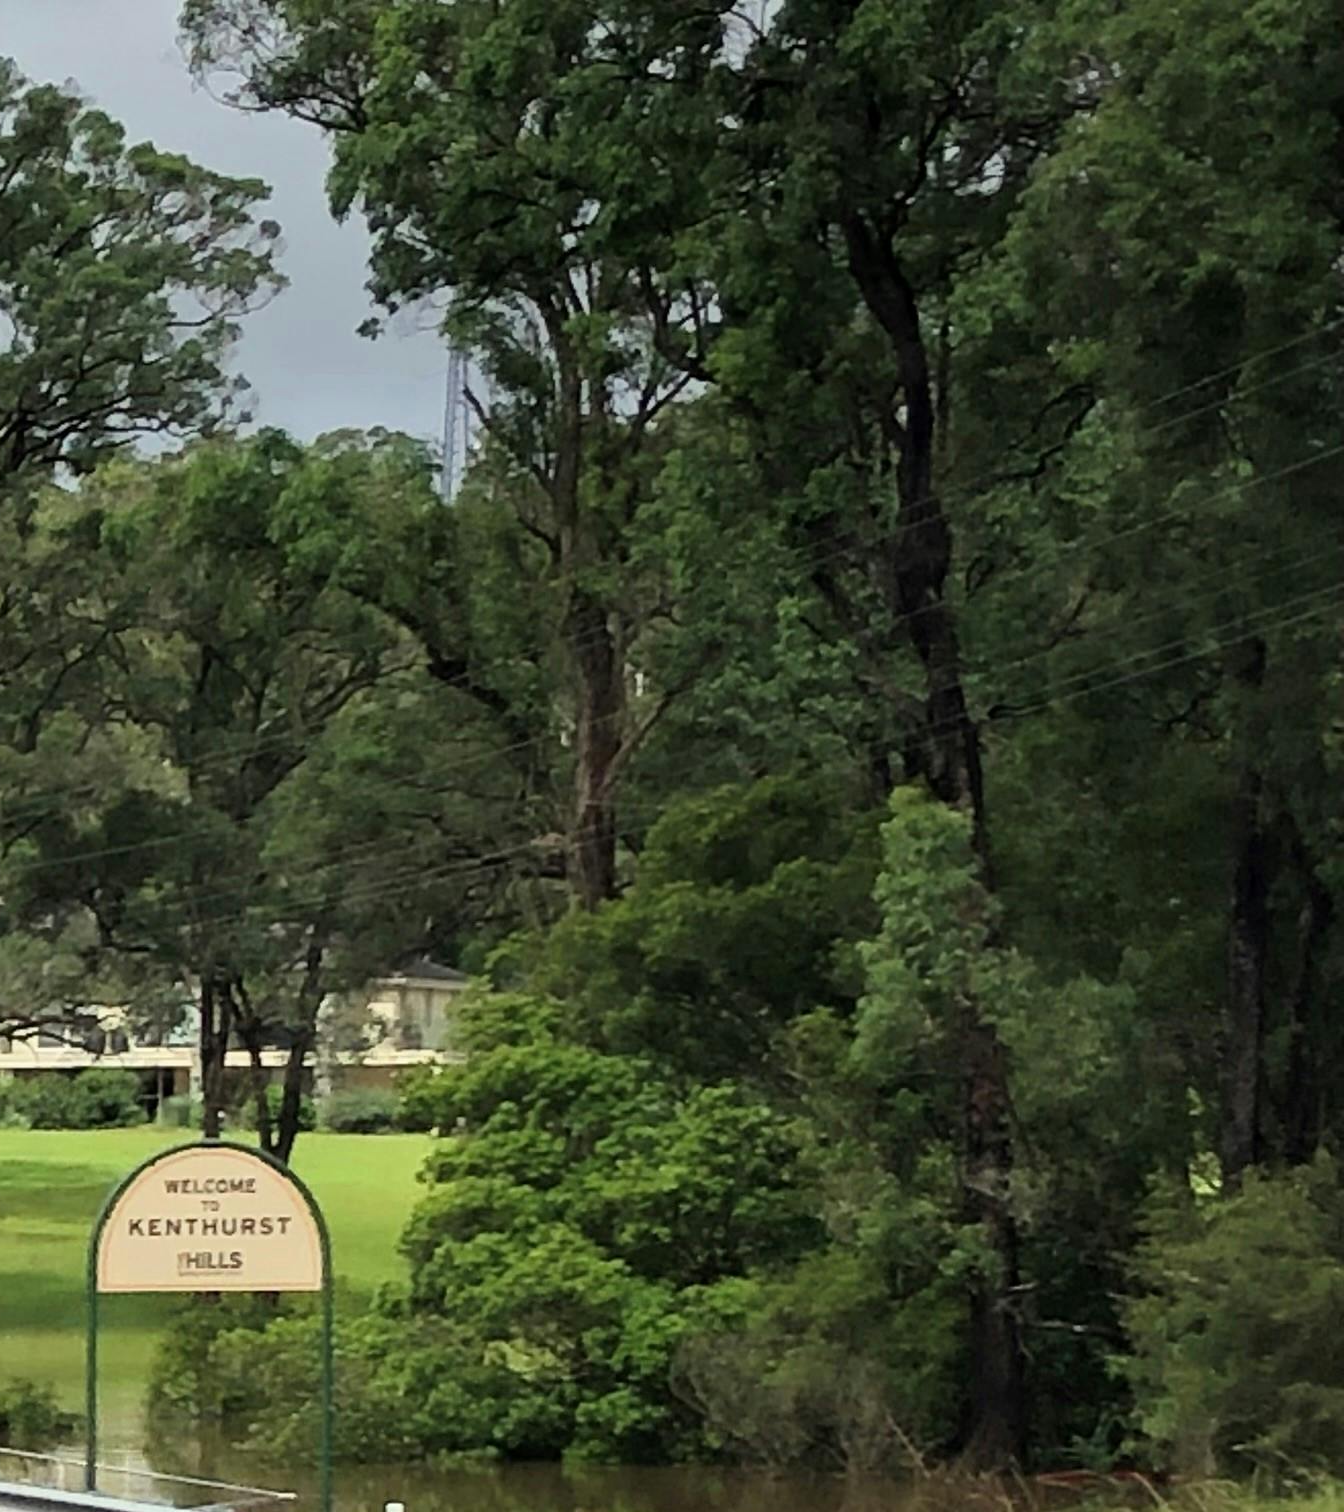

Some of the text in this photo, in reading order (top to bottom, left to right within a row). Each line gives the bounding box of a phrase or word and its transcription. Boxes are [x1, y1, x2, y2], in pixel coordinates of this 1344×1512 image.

[164, 1178, 256, 1194] WELCOME
[200, 1200, 221, 1212] TO
[128, 1217, 292, 1237] KENTHURST
